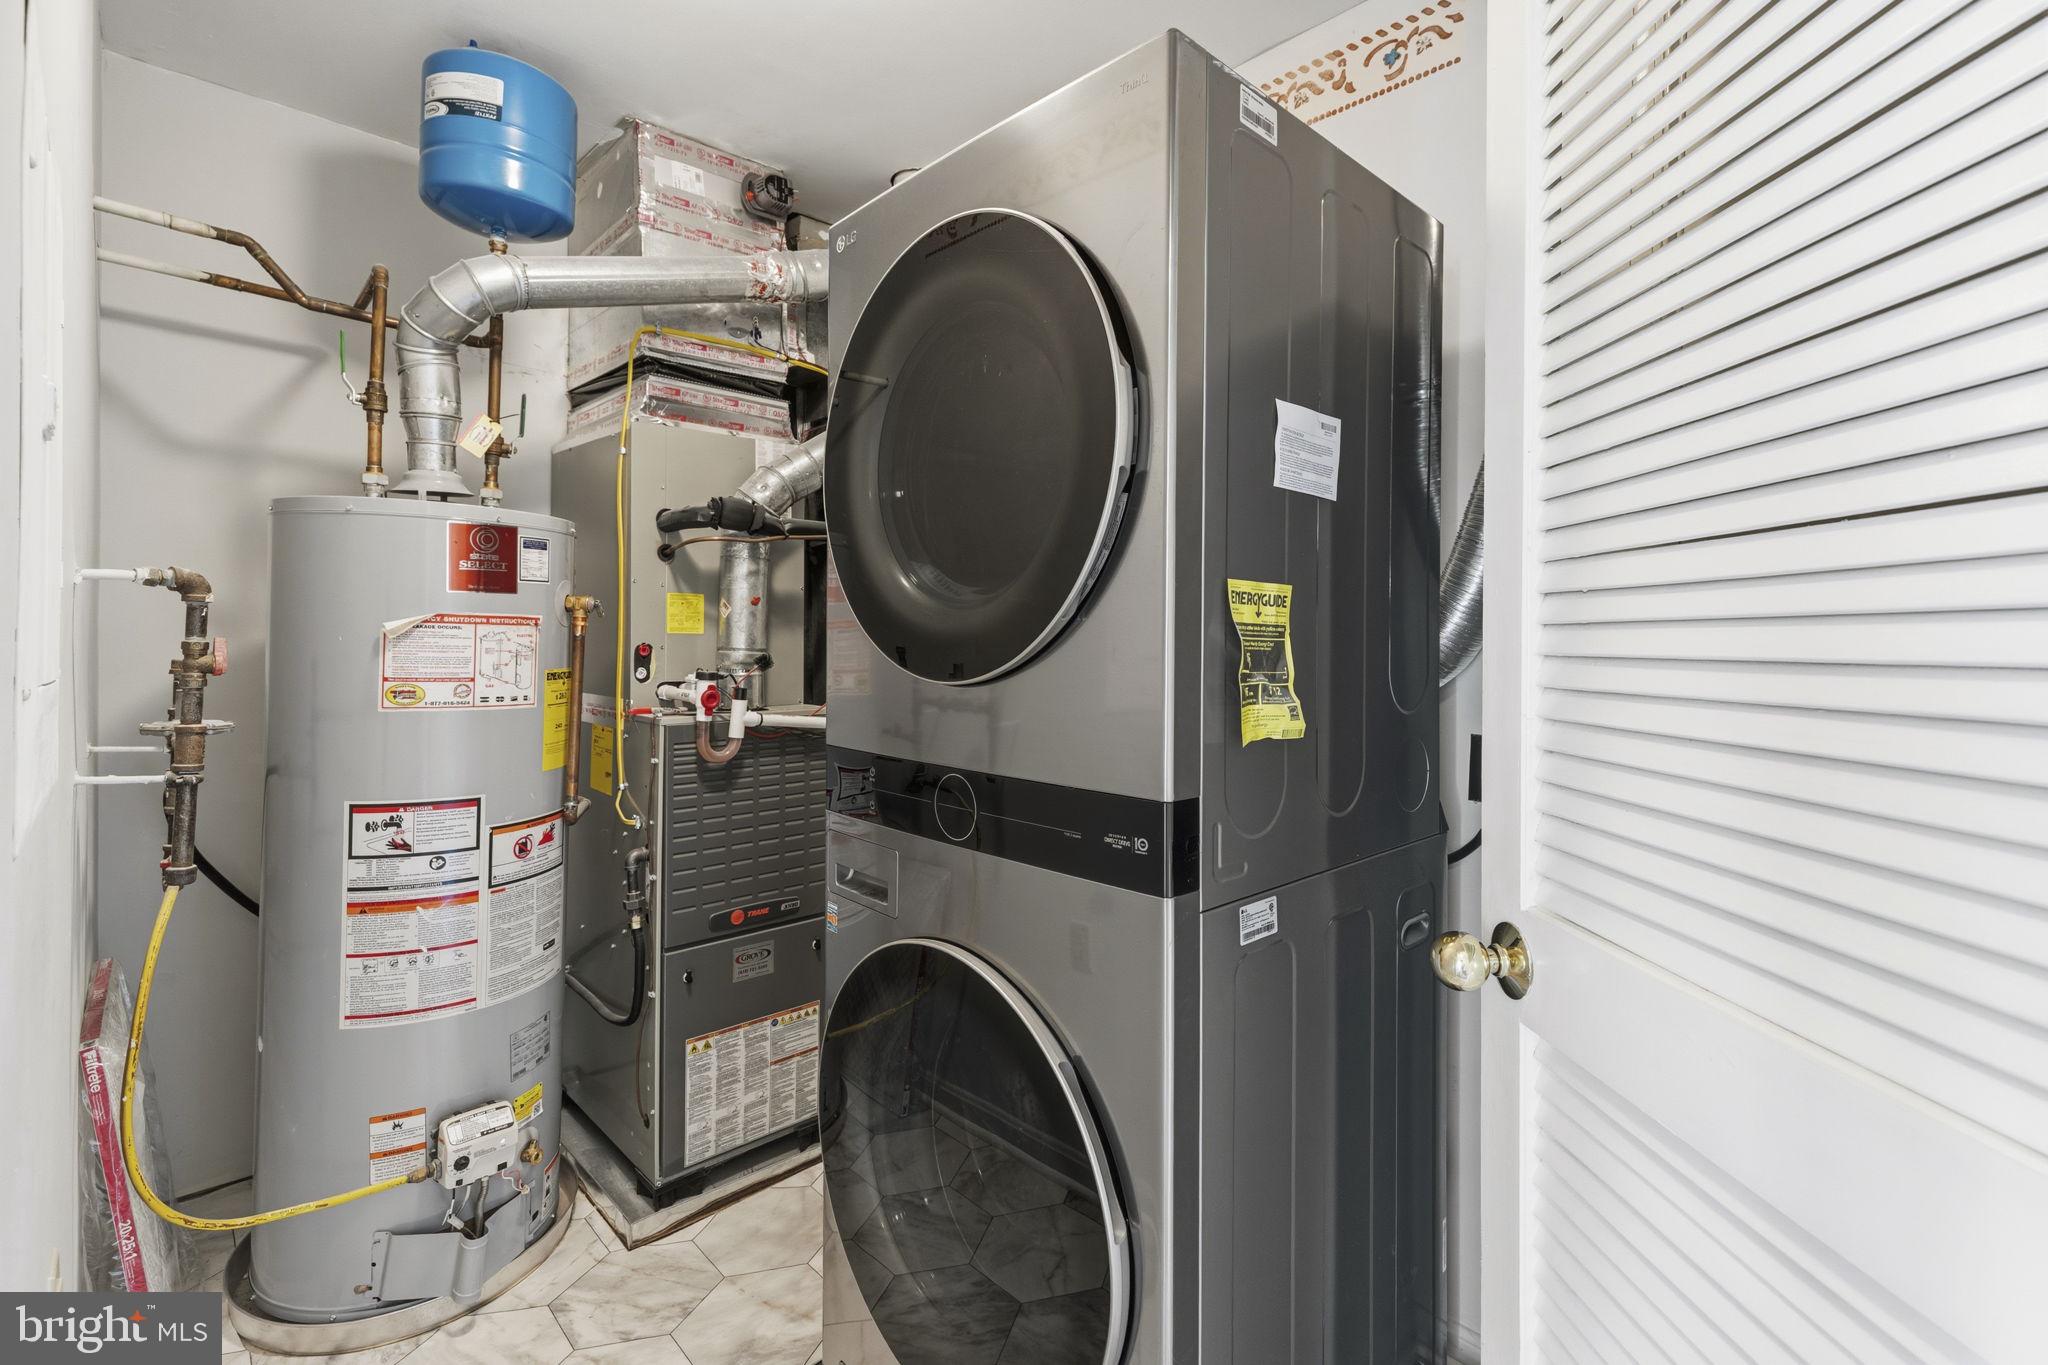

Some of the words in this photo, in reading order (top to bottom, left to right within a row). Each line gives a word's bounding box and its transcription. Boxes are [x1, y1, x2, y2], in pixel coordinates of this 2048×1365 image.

[1120, 72, 1149, 95] ThinQ
[846, 230, 857, 245] LG
[458, 560, 509, 570] SELECT
[1230, 590, 1288, 608] ENERGYGUIDE
[443, 616, 487, 624] SHUTDOWN
[747, 907, 770, 918] TRANE
[83, 1050, 101, 1093] Filtrete
[119, 1219, 138, 1261] 20x25x1
